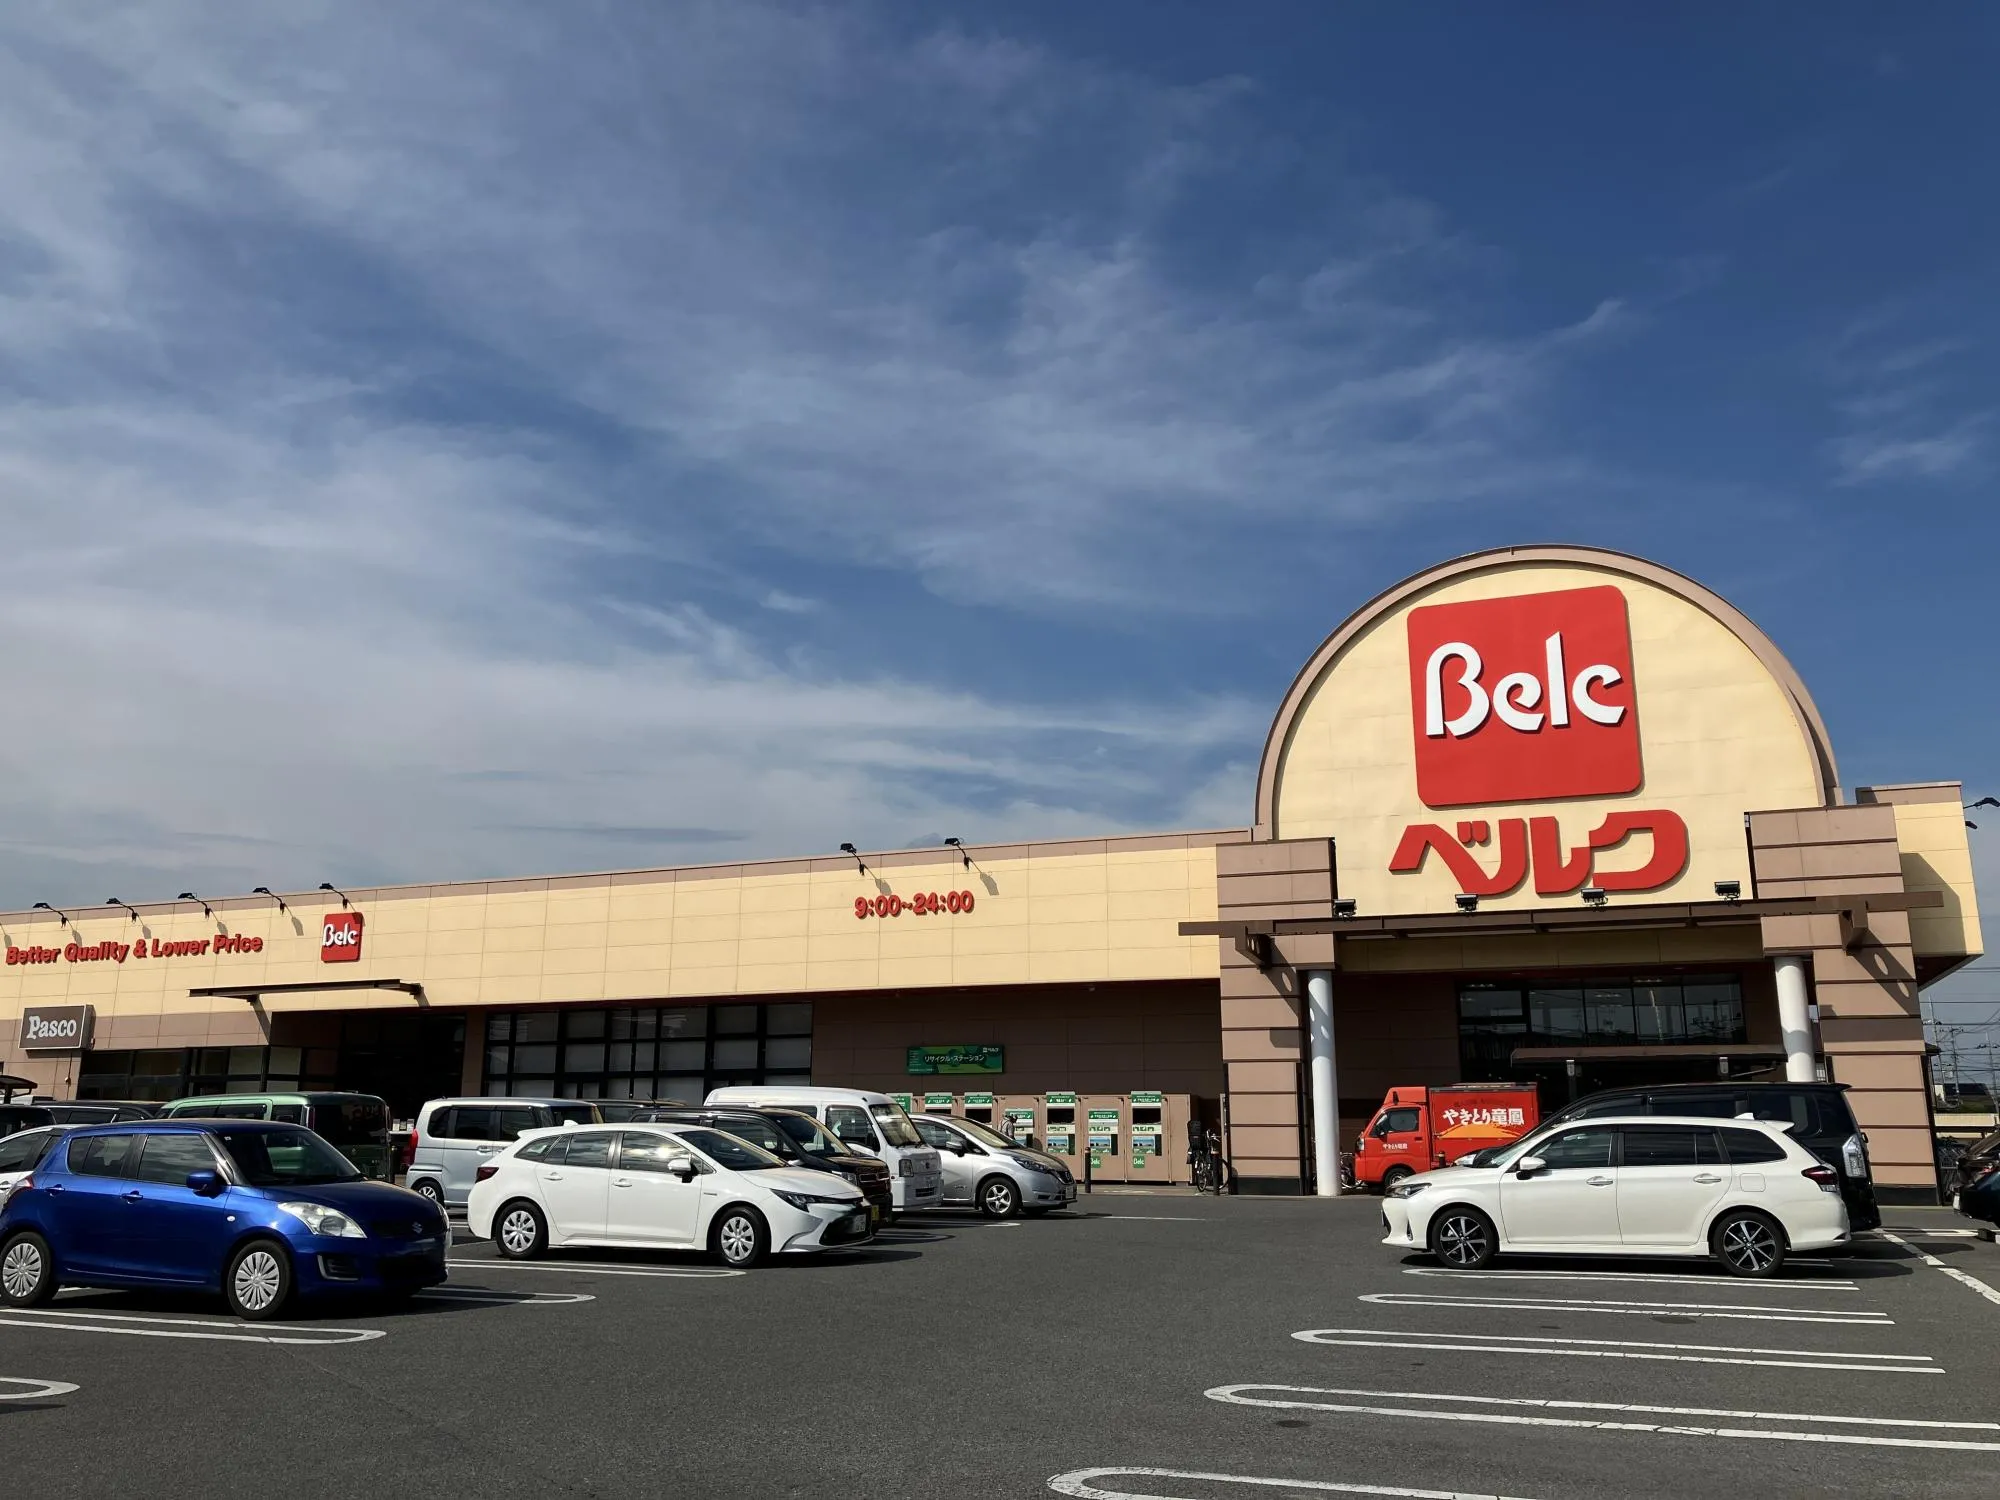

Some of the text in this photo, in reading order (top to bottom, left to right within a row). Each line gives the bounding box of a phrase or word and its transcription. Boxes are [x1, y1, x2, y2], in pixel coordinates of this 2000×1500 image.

[1425, 631, 1626, 737] Belc
[1388, 808, 1690, 897] ベルク
[5, 933, 264, 965] Better Quality & Lower Price
[322, 922, 358, 947] Belc
[26, 1015, 77, 1040] Pasco
